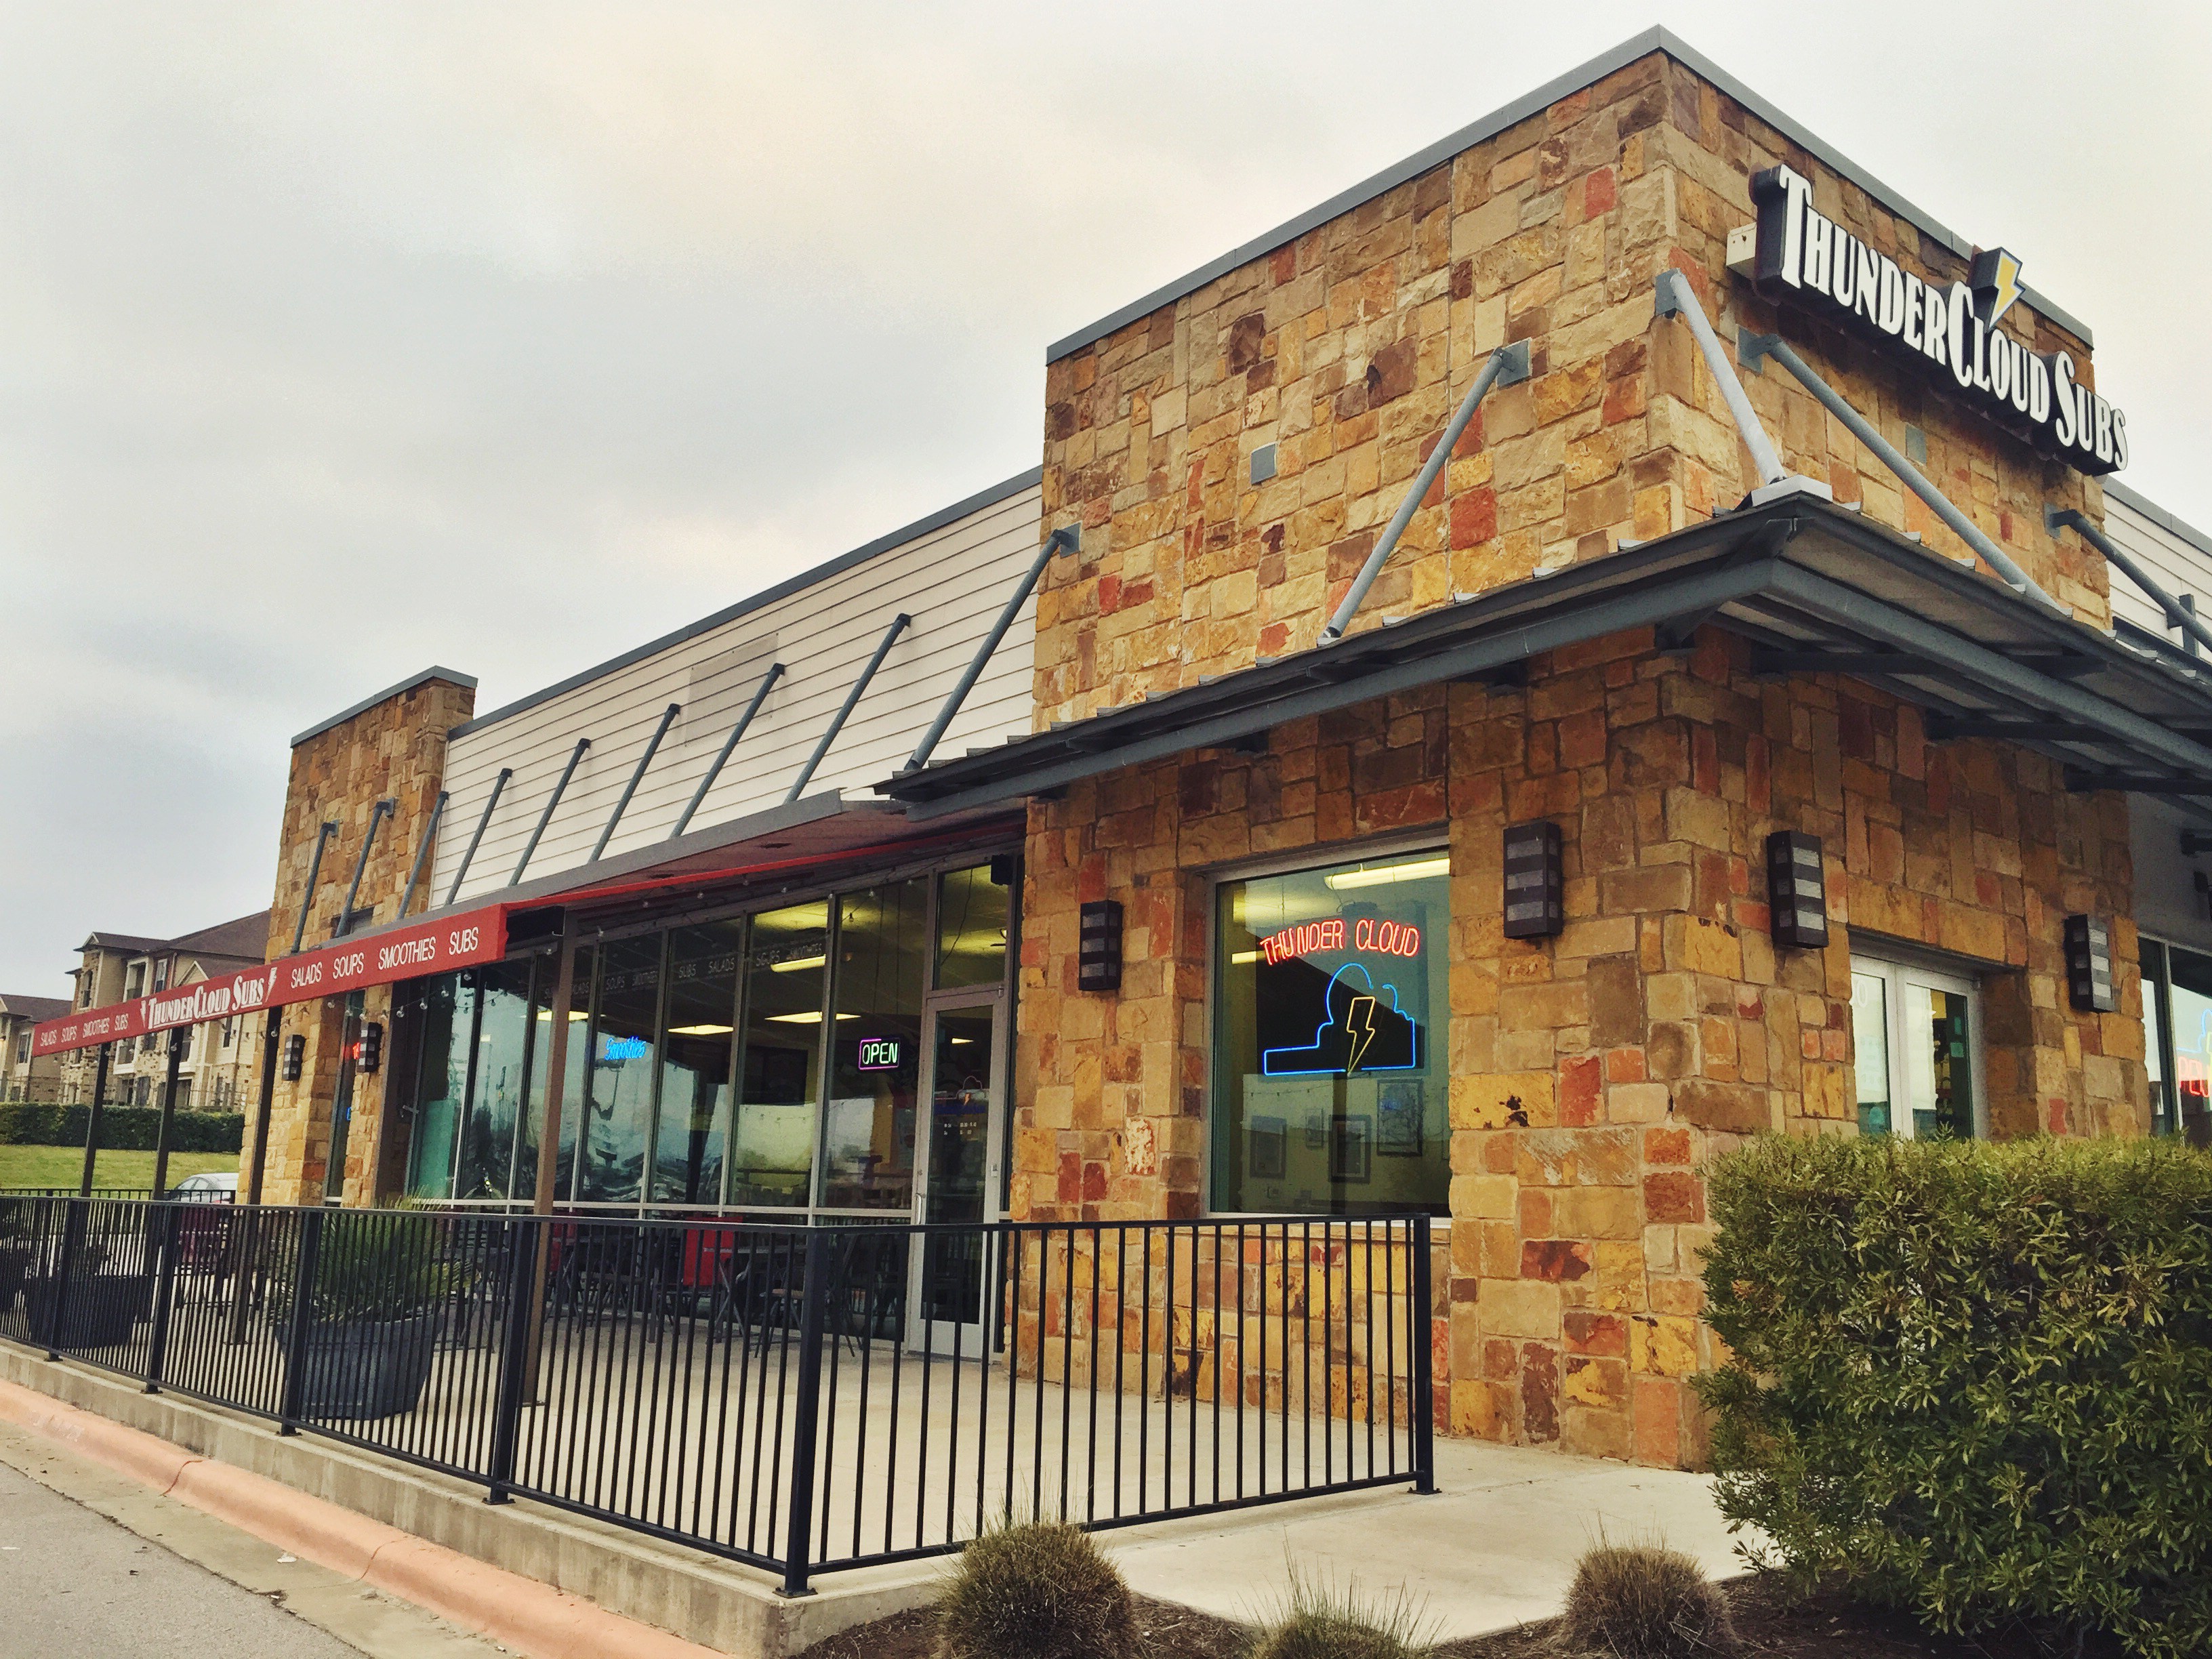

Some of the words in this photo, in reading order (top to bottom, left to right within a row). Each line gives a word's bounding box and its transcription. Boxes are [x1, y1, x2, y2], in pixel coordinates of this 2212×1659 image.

[2055, 351, 2128, 471] SUBS
[291, 962, 322, 989] SALADS
[333, 952, 365, 979] SOUPS
[378, 936, 436, 970] SMOOTHIES
[449, 926, 478, 955] SUBS
[1260, 919, 1345, 965] THUNDER
[1355, 919, 1420, 957] CLOUD
[232, 975, 264, 1011] SUBS
[40, 1029, 57, 1047] SALADS
[61, 1025, 77, 1043] SOUPS
[83, 1017, 110, 1038] SMOOTHIES
[115, 1013, 129, 1031] SUBS
[862, 1042, 898, 1065] OPEN
